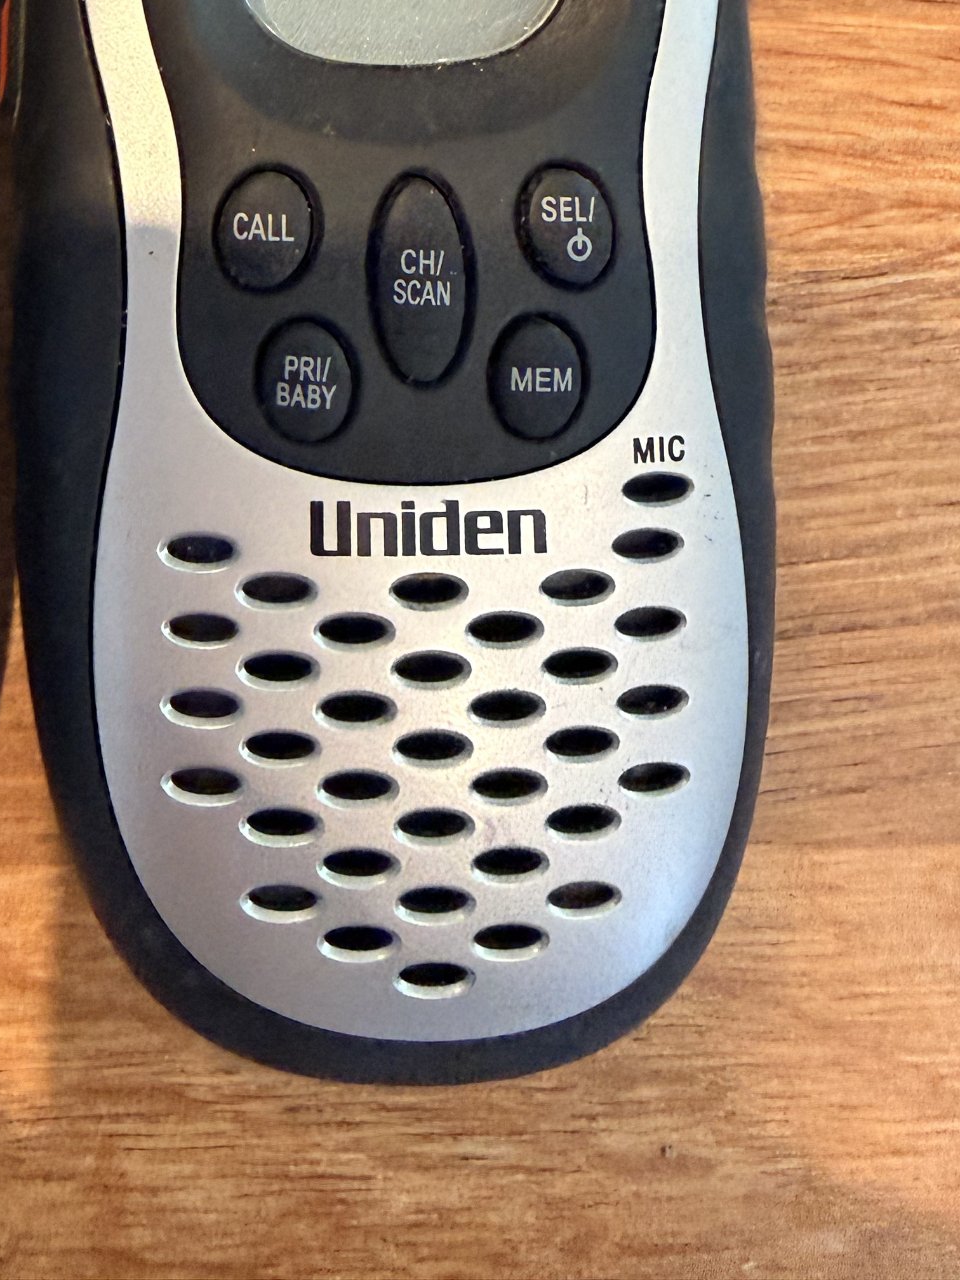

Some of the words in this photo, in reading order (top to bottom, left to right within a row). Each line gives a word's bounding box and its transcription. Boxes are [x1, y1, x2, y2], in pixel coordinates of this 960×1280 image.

[541, 196, 596, 223] SEL/
[232, 212, 295, 243] CALL
[400, 249, 445, 277] CH/
[393, 279, 451, 307] SCAN
[283, 355, 332, 383] PRI/
[510, 366, 573, 393] MEM
[275, 381, 338, 411] BABY
[633, 435, 686, 464] MIC
[309, 499, 548, 558] Uniden
